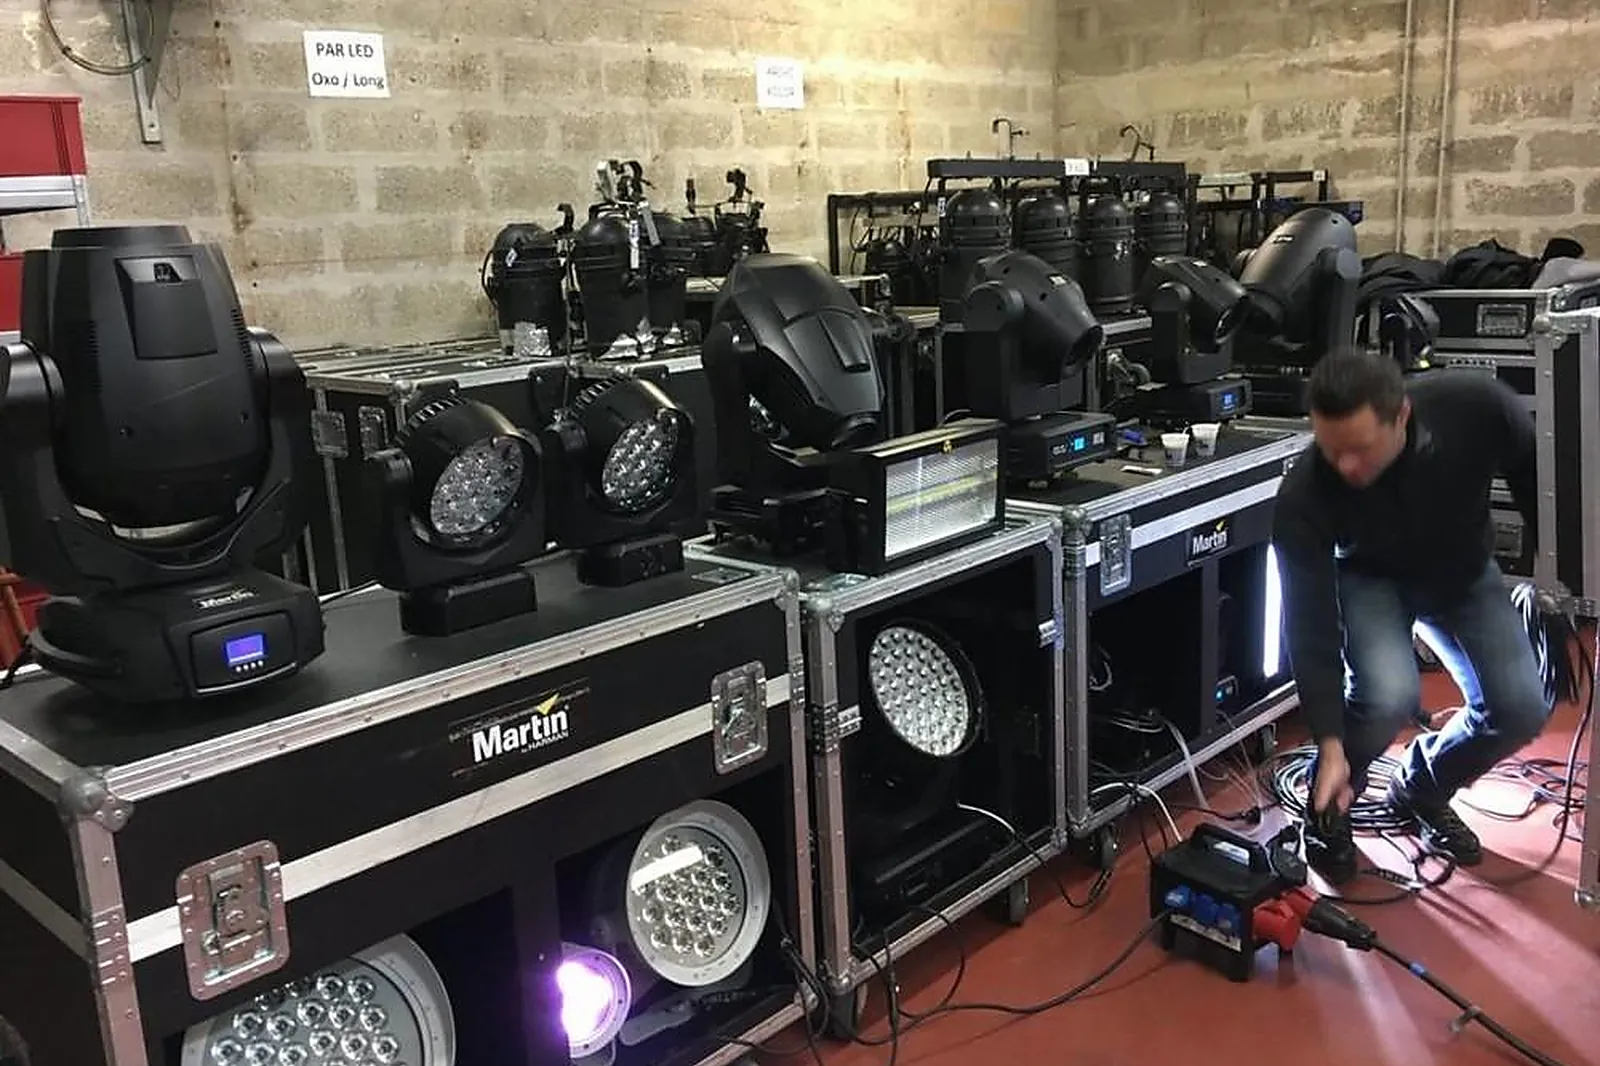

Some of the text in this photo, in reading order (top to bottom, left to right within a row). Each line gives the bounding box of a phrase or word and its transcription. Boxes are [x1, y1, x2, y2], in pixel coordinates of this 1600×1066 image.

[316, 42, 374, 58] PAR LED
[343, 72, 349, 89] /
[353, 73, 385, 90] Long
[472, 704, 569, 763] Martin
